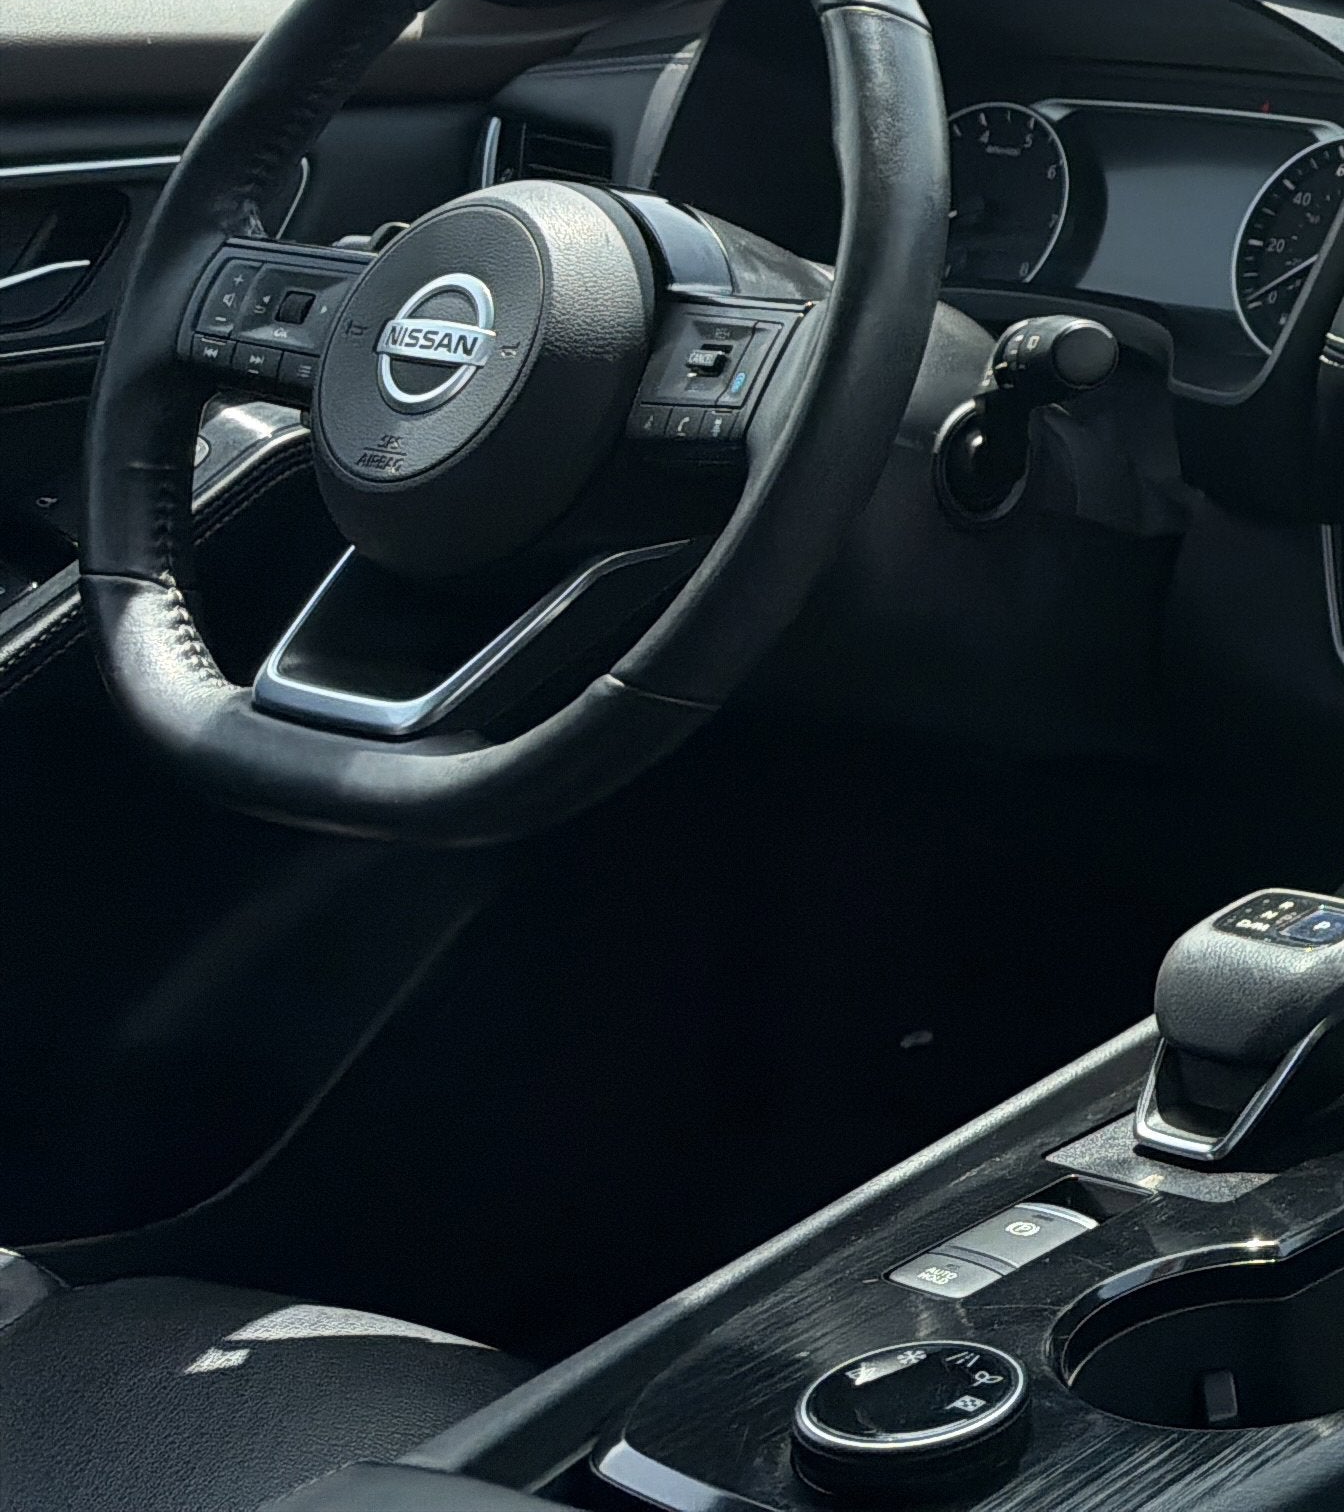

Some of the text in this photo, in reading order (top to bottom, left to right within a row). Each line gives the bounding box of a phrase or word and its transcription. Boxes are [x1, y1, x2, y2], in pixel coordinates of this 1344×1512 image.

[1293, 192, 1312, 206] 40
[1267, 238, 1286, 253] 20
[385, 326, 479, 356] NISSAN
[1312, 920, 1332, 932] P
[917, 1270, 950, 1285] HOLD
[923, 1266, 958, 1281] AUTO
